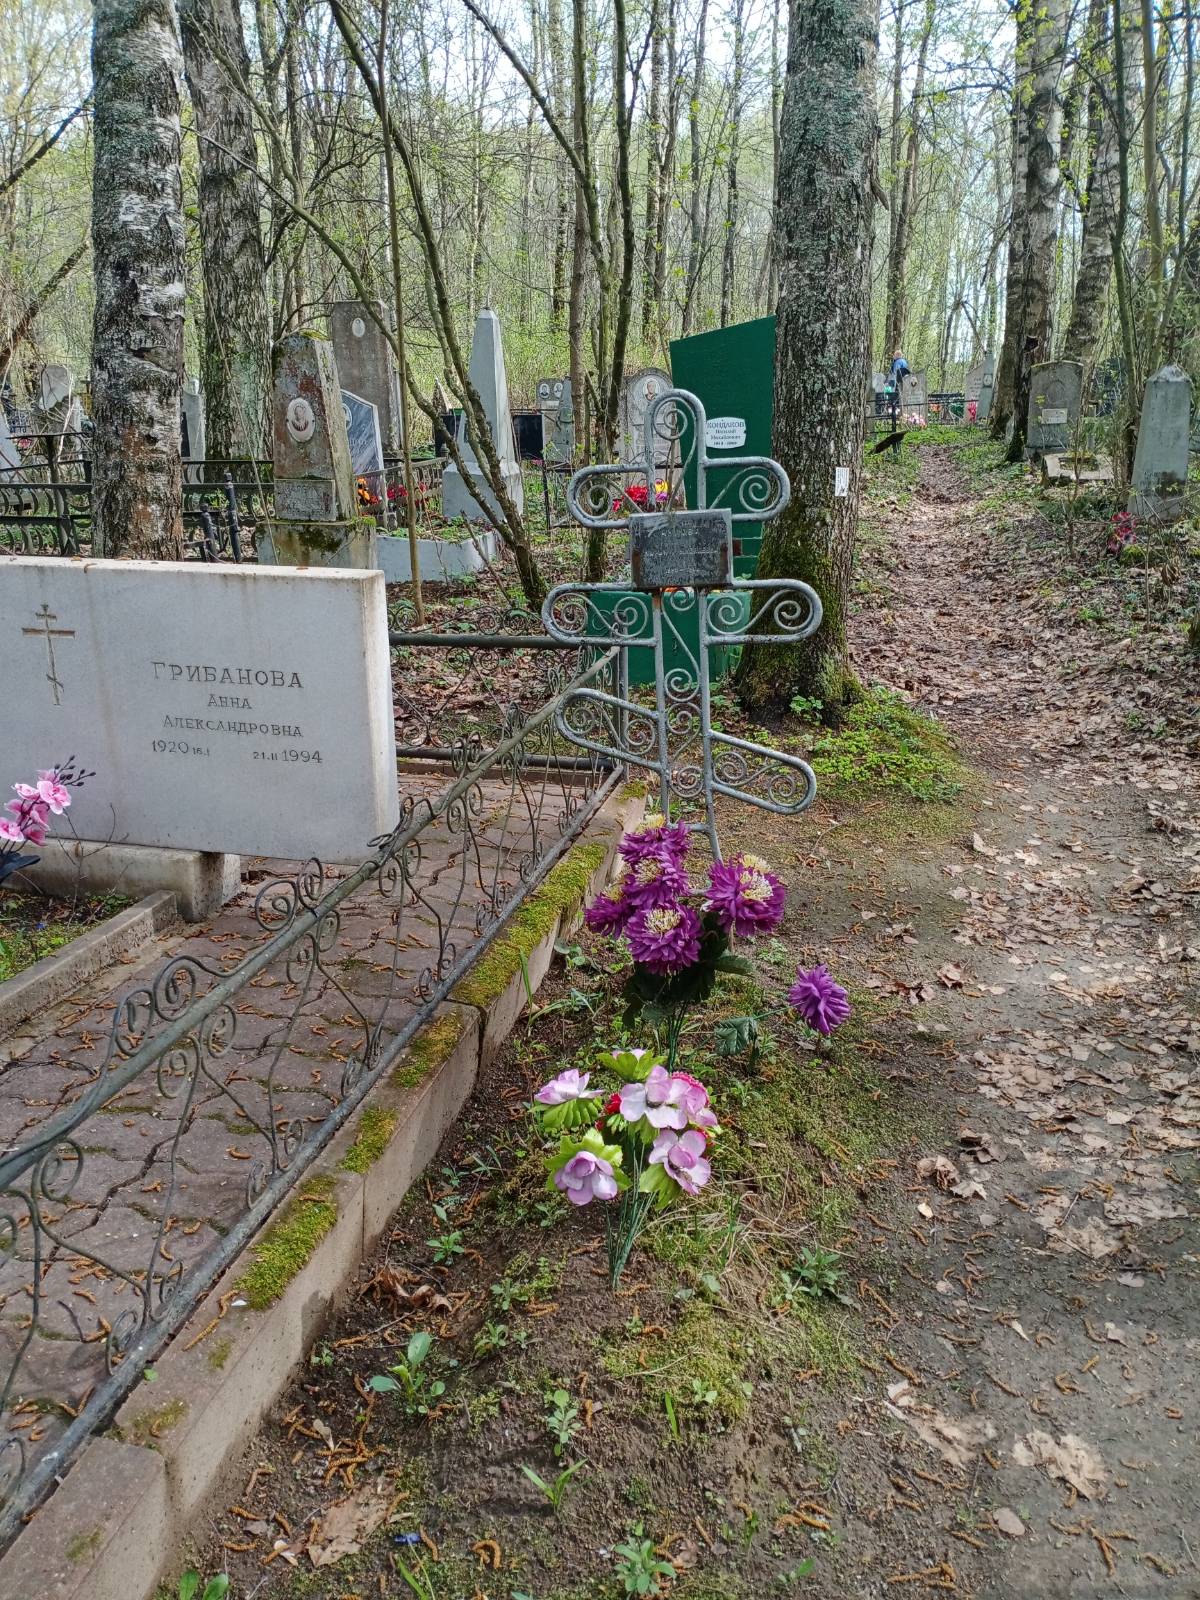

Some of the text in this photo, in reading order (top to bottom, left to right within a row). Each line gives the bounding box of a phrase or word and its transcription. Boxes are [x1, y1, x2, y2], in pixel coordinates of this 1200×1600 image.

[151, 661, 304, 688] ГРИБАНОВА
[207, 694, 252, 709] АННА
[163, 715, 304, 737] АЛЕКСАНДРОВНА
[151, 739, 189, 754] 1920
[281, 749, 323, 764] 1994
